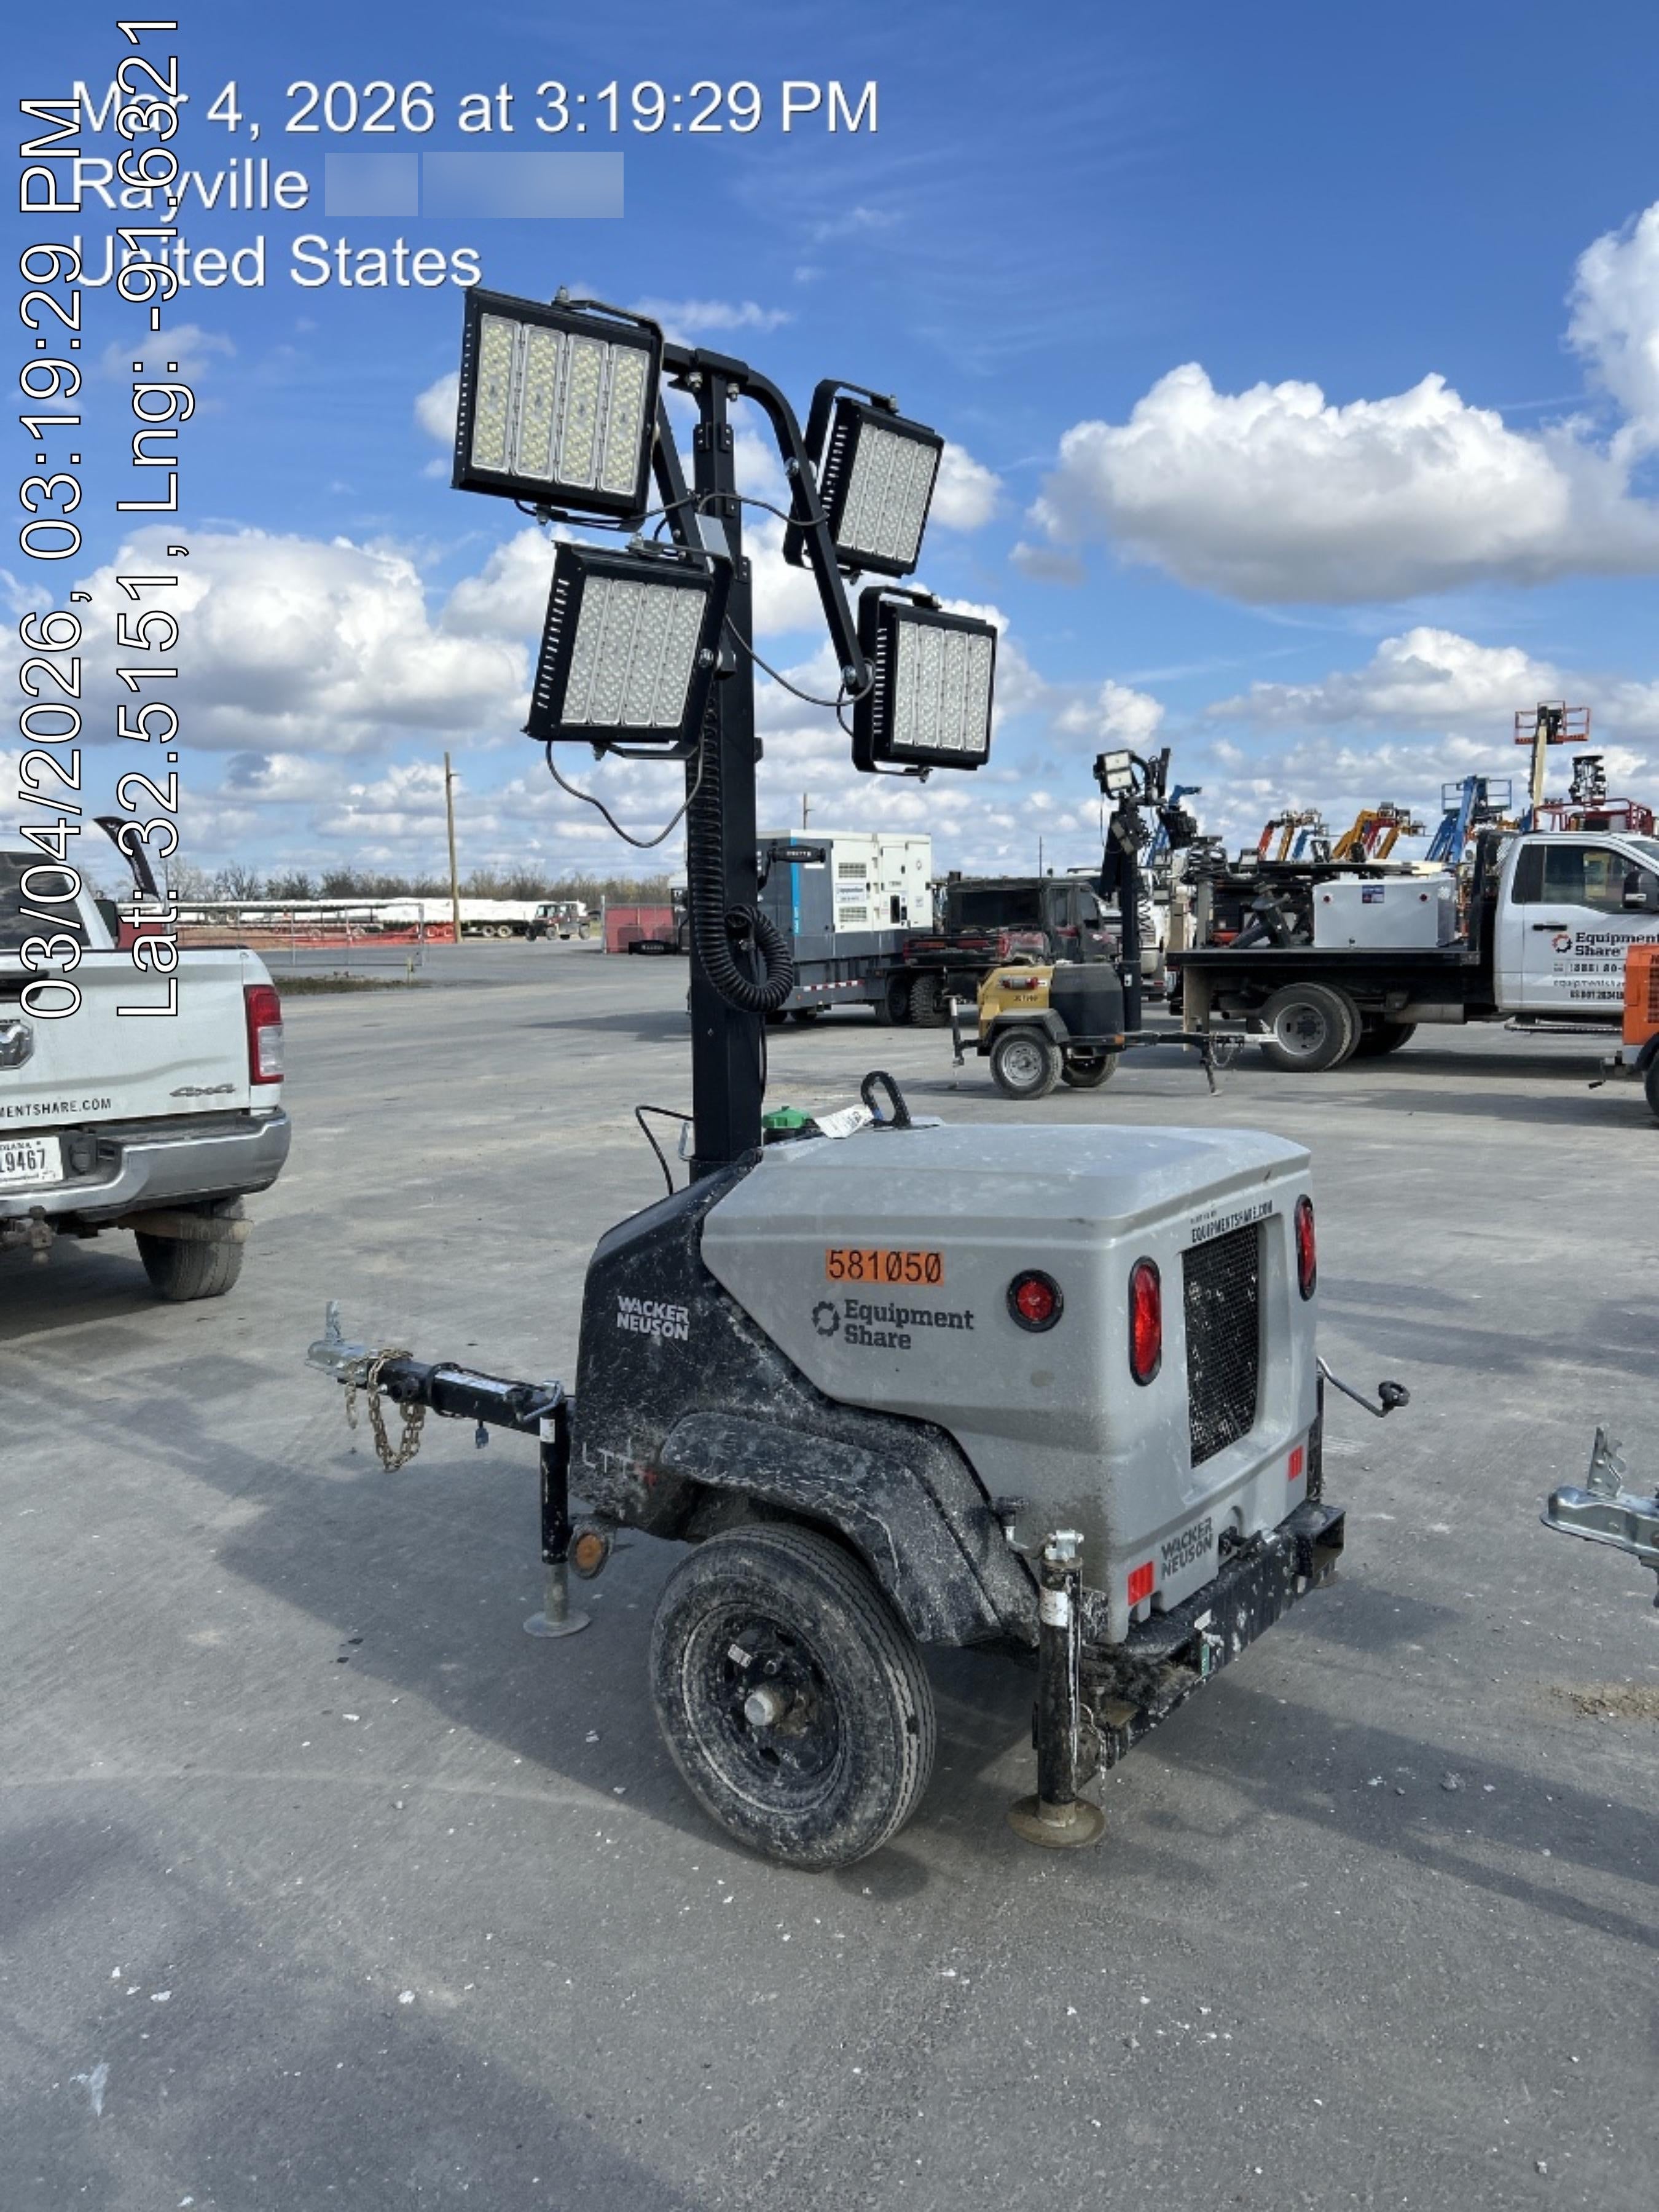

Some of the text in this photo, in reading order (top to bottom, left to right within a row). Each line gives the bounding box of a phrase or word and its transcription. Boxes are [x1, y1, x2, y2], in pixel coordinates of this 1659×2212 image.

[830, 1250, 941, 1283] 581050
[617, 1295, 689, 1324] WACKER
[844, 1299, 975, 1330] Equipment
[617, 1312, 689, 1341] NEUSON
[844, 1324, 911, 1350] Share
[1161, 1516, 1212, 1561] WACKER
[1161, 1533, 1213, 1581] NEUSON
